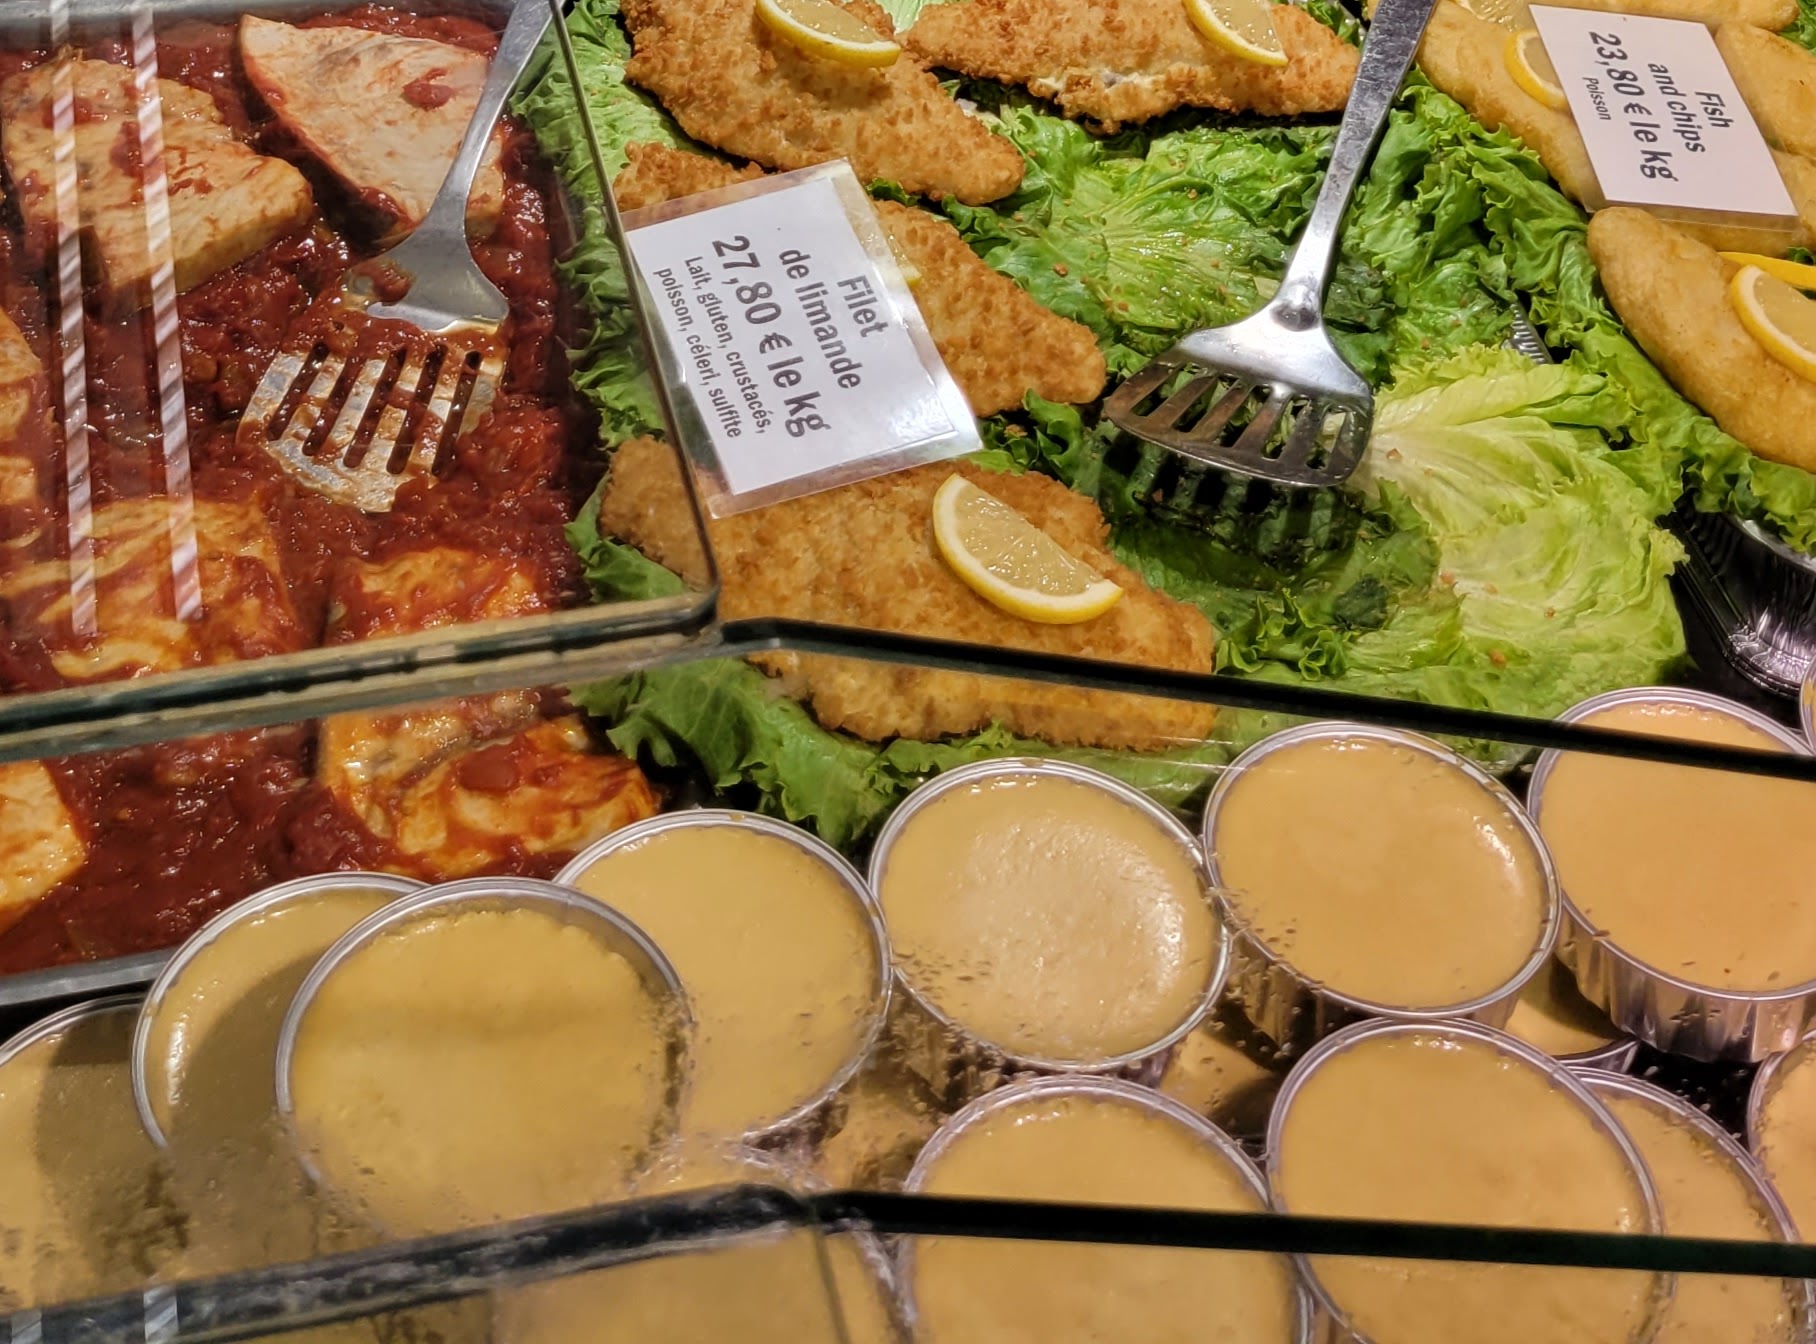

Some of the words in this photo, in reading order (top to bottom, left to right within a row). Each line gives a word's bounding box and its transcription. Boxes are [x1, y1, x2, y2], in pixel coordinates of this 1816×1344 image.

[1588, 30, 1646, 97] 23,80
[1581, 75, 1613, 122] Poisson
[1623, 101, 1653, 116] €
[1647, 62, 1687, 98] and
[1667, 100, 1707, 154] chips
[1695, 91, 1734, 129] Fish
[1629, 120, 1662, 144] le
[1639, 149, 1680, 183] kg
[684, 255, 713, 291] Lait,
[711, 234, 783, 326] 27,80
[778, 248, 813, 280] de
[697, 291, 736, 350] gluten,
[837, 274, 889, 338] Filet
[653, 267, 696, 332] poisson,
[686, 332, 722, 387] céleri,
[707, 387, 743, 439] sulfite
[758, 331, 793, 355] €
[795, 280, 866, 390] limande
[725, 350, 773, 435] crustacés,
[766, 356, 805, 389] le
[783, 390, 833, 438] kg
